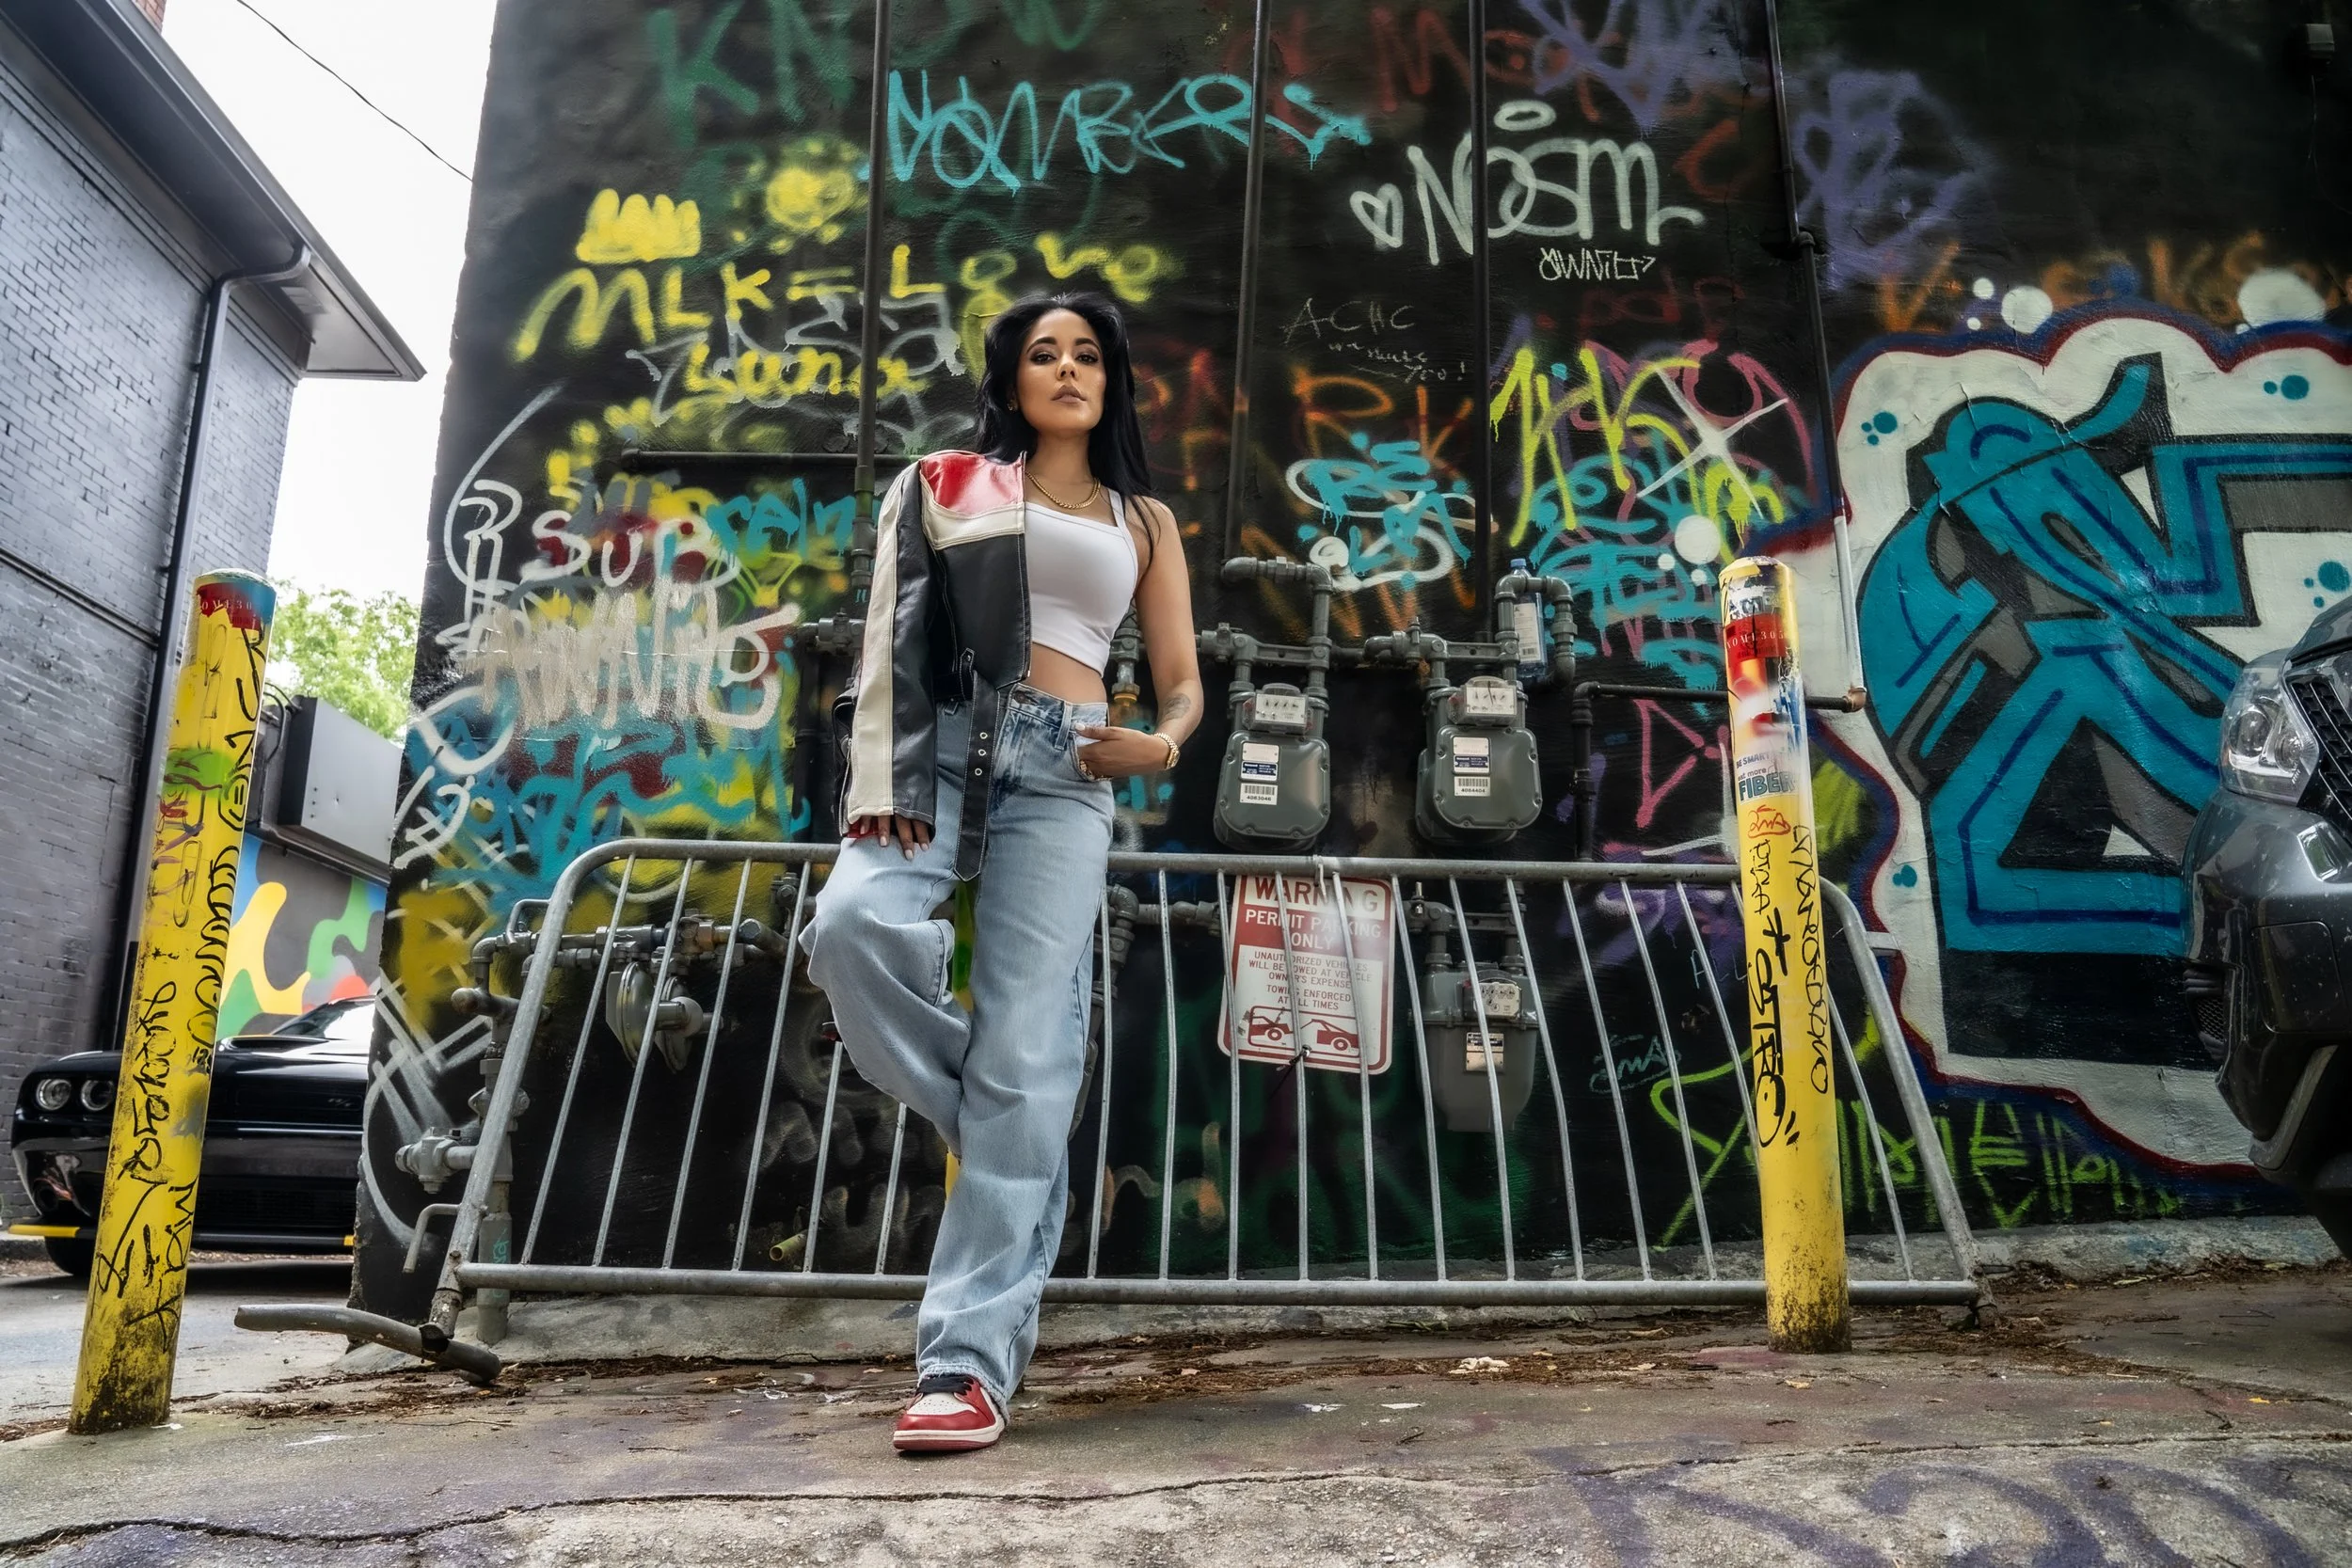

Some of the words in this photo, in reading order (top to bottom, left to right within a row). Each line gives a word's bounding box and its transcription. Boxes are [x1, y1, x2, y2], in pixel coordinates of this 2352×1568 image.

[1747, 768, 1767, 777] more
[1738, 771, 1796, 801] FIBER
[1291, 932, 1333, 950] ONLY
[1248, 959, 1269, 970] WILL
[1273, 962, 1284, 972] BE
[1293, 965, 1317, 975] OWED
[1268, 972, 1307, 984] OWNR'S
[1311, 977, 1352, 990] EXPENSE
[1278, 996, 1289, 1005] AT
[1297, 998, 1309, 1007] LL
[1312, 999, 1340, 1010] TIMES
[1303, 989, 1352, 1003] ENFORCED
